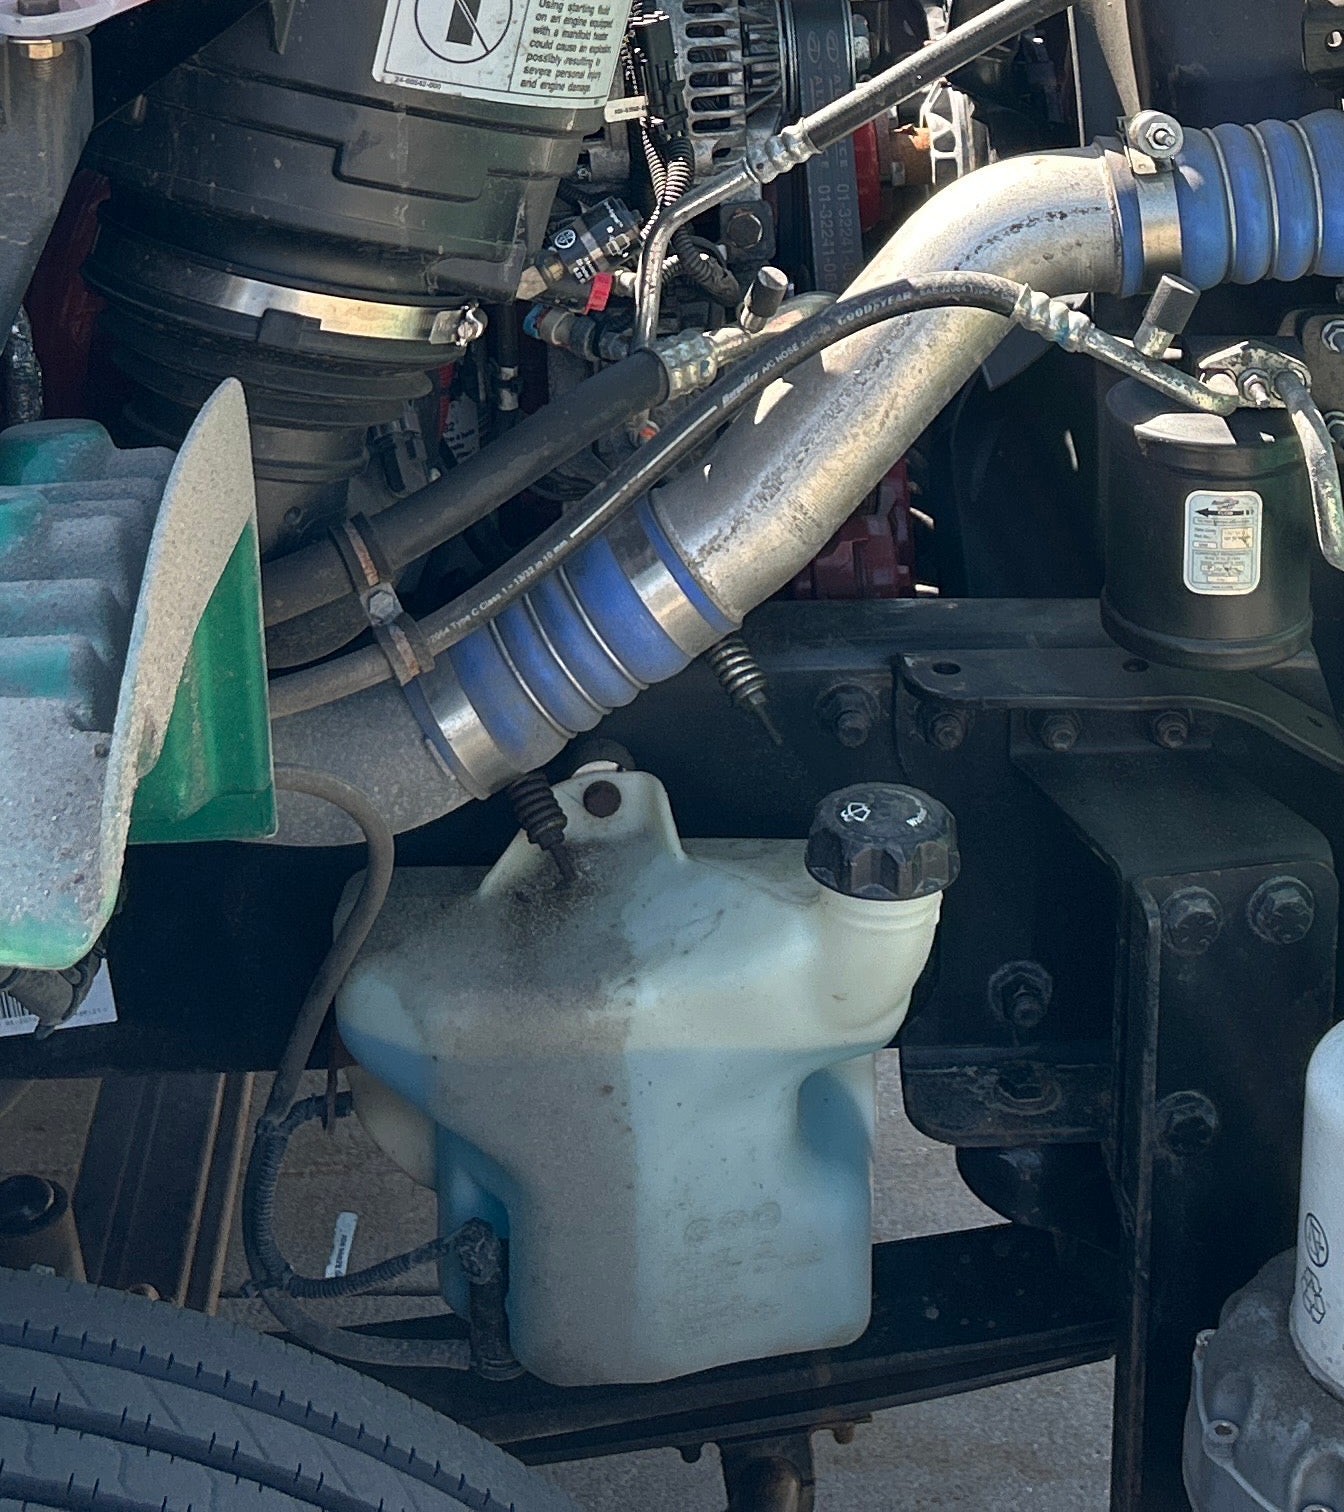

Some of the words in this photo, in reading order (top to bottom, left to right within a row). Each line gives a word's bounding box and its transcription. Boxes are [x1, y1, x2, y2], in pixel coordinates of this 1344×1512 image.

[568, 1, 594, 16] starting
[536, 14, 546, 23] on
[564, 15, 587, 28] engine
[533, 26, 550, 37] with
[530, 39, 553, 50] could
[526, 53, 562, 66] possibly
[524, 65, 551, 79] severe
[521, 79, 540, 89] and
[543, 79, 565, 93] engine
[773, 342, 799, 363] HOSE
[450, 613, 471, 630] Type
[470, 607, 479, 616] C
[477, 591, 502, 611] Class
[512, 566, 536, 585] 13/32
[542, 550, 554, 562] 10
